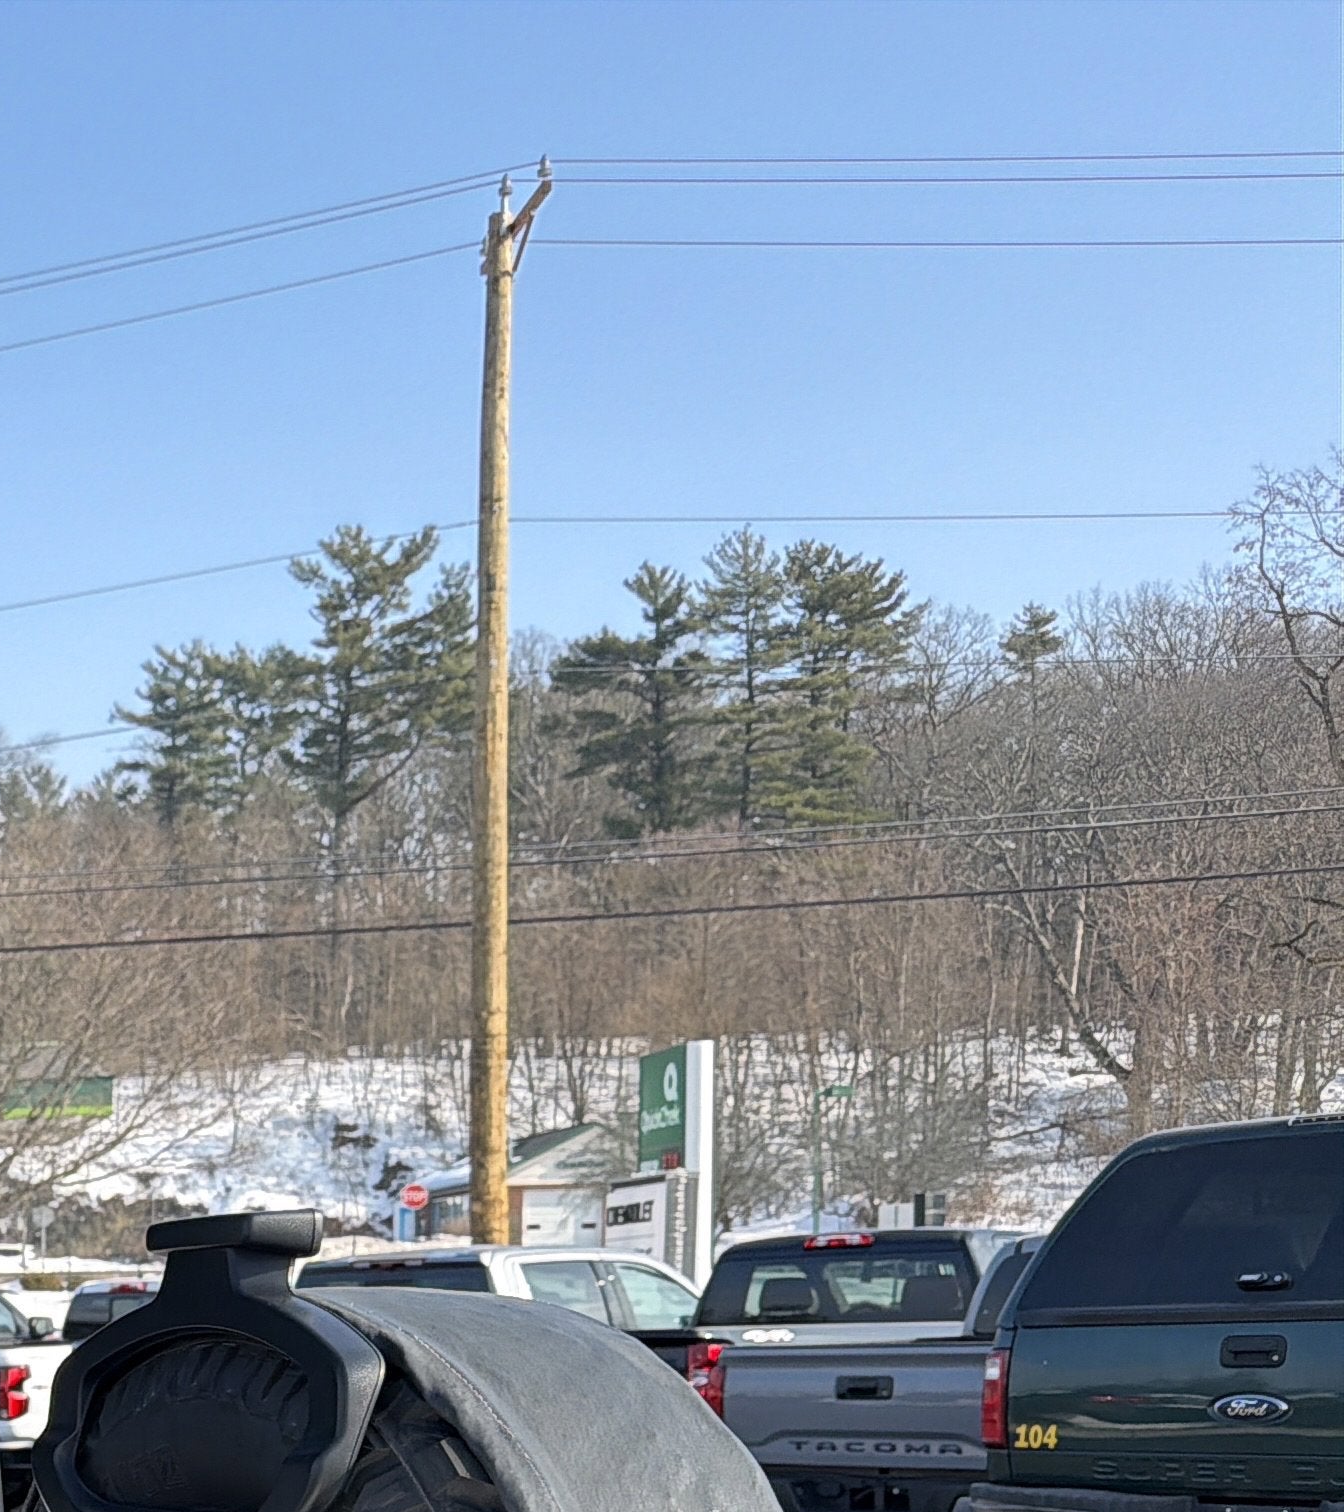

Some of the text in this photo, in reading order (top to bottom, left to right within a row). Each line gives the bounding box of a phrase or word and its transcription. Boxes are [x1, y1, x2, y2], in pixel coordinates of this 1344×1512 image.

[1226, 1399, 1268, 1418] Ford
[787, 1439, 964, 1456] TACOMA
[1014, 1423, 1059, 1450] 104
[1091, 1458, 1253, 1485] SUPER
